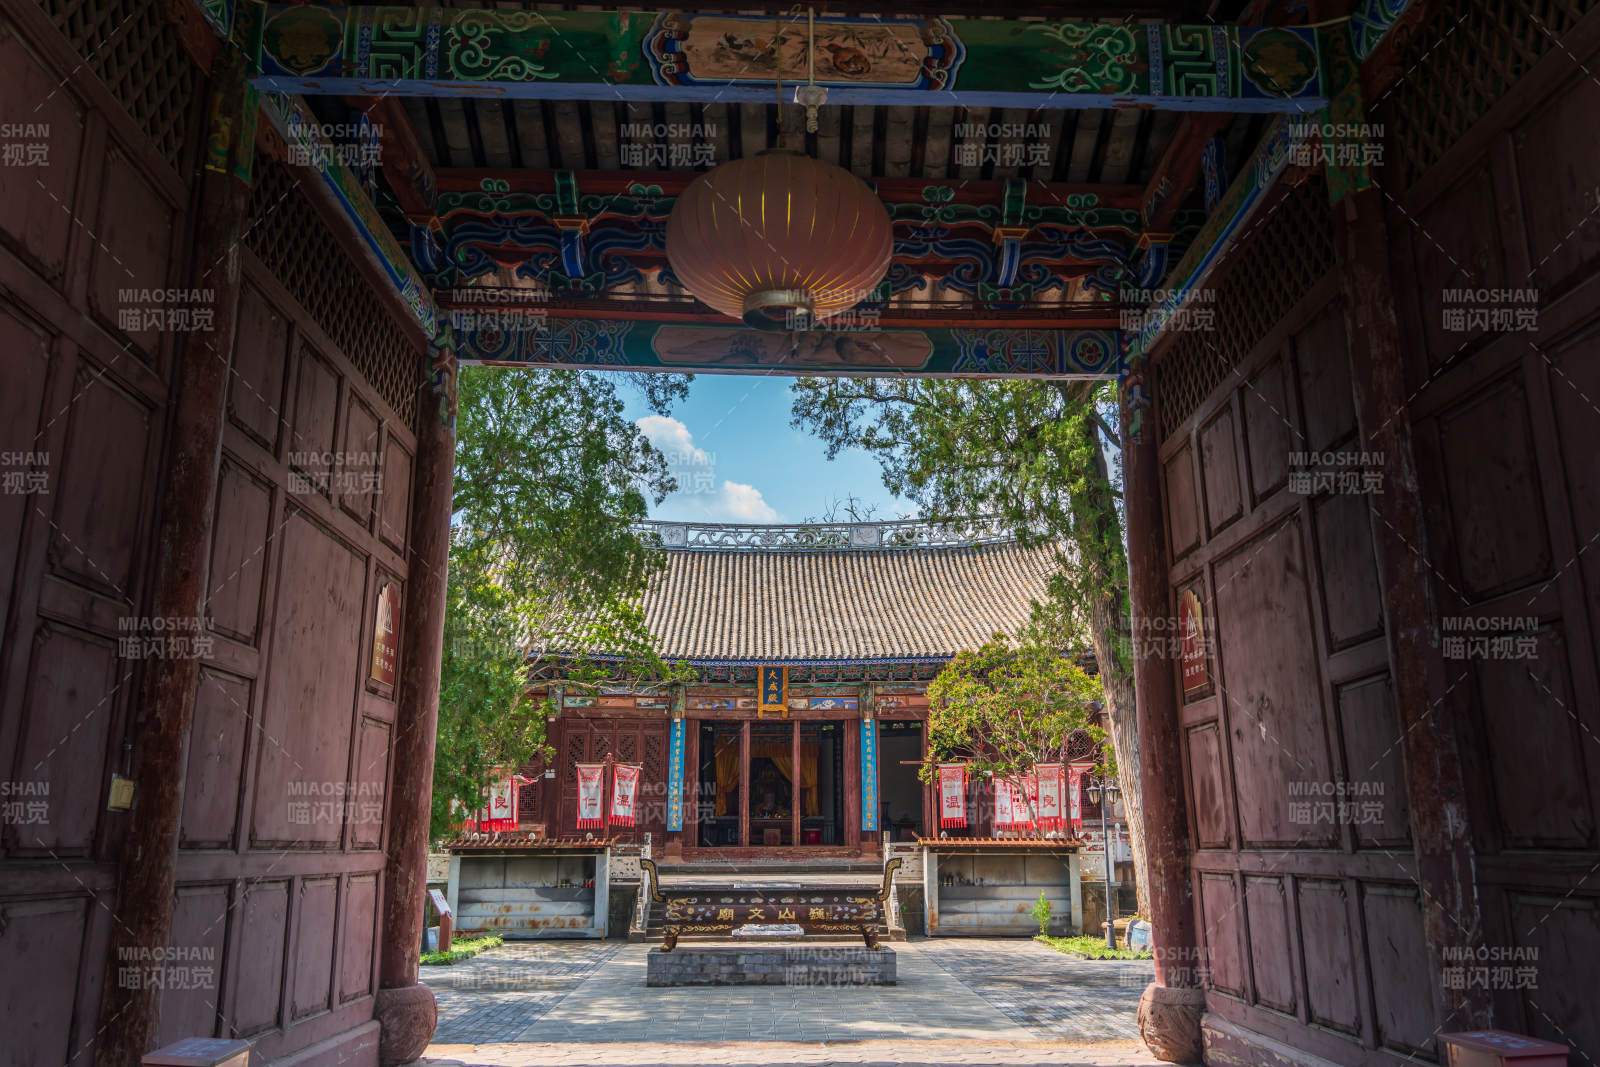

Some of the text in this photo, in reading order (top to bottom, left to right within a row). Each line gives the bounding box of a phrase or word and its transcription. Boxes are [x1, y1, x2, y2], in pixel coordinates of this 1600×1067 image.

[768, 669, 778, 703] 大成殿
[494, 795, 509, 810] 良
[583, 796, 598, 810] 仁
[616, 793, 631, 807] 温
[945, 795, 961, 809] 温
[1042, 795, 1056, 809] 良
